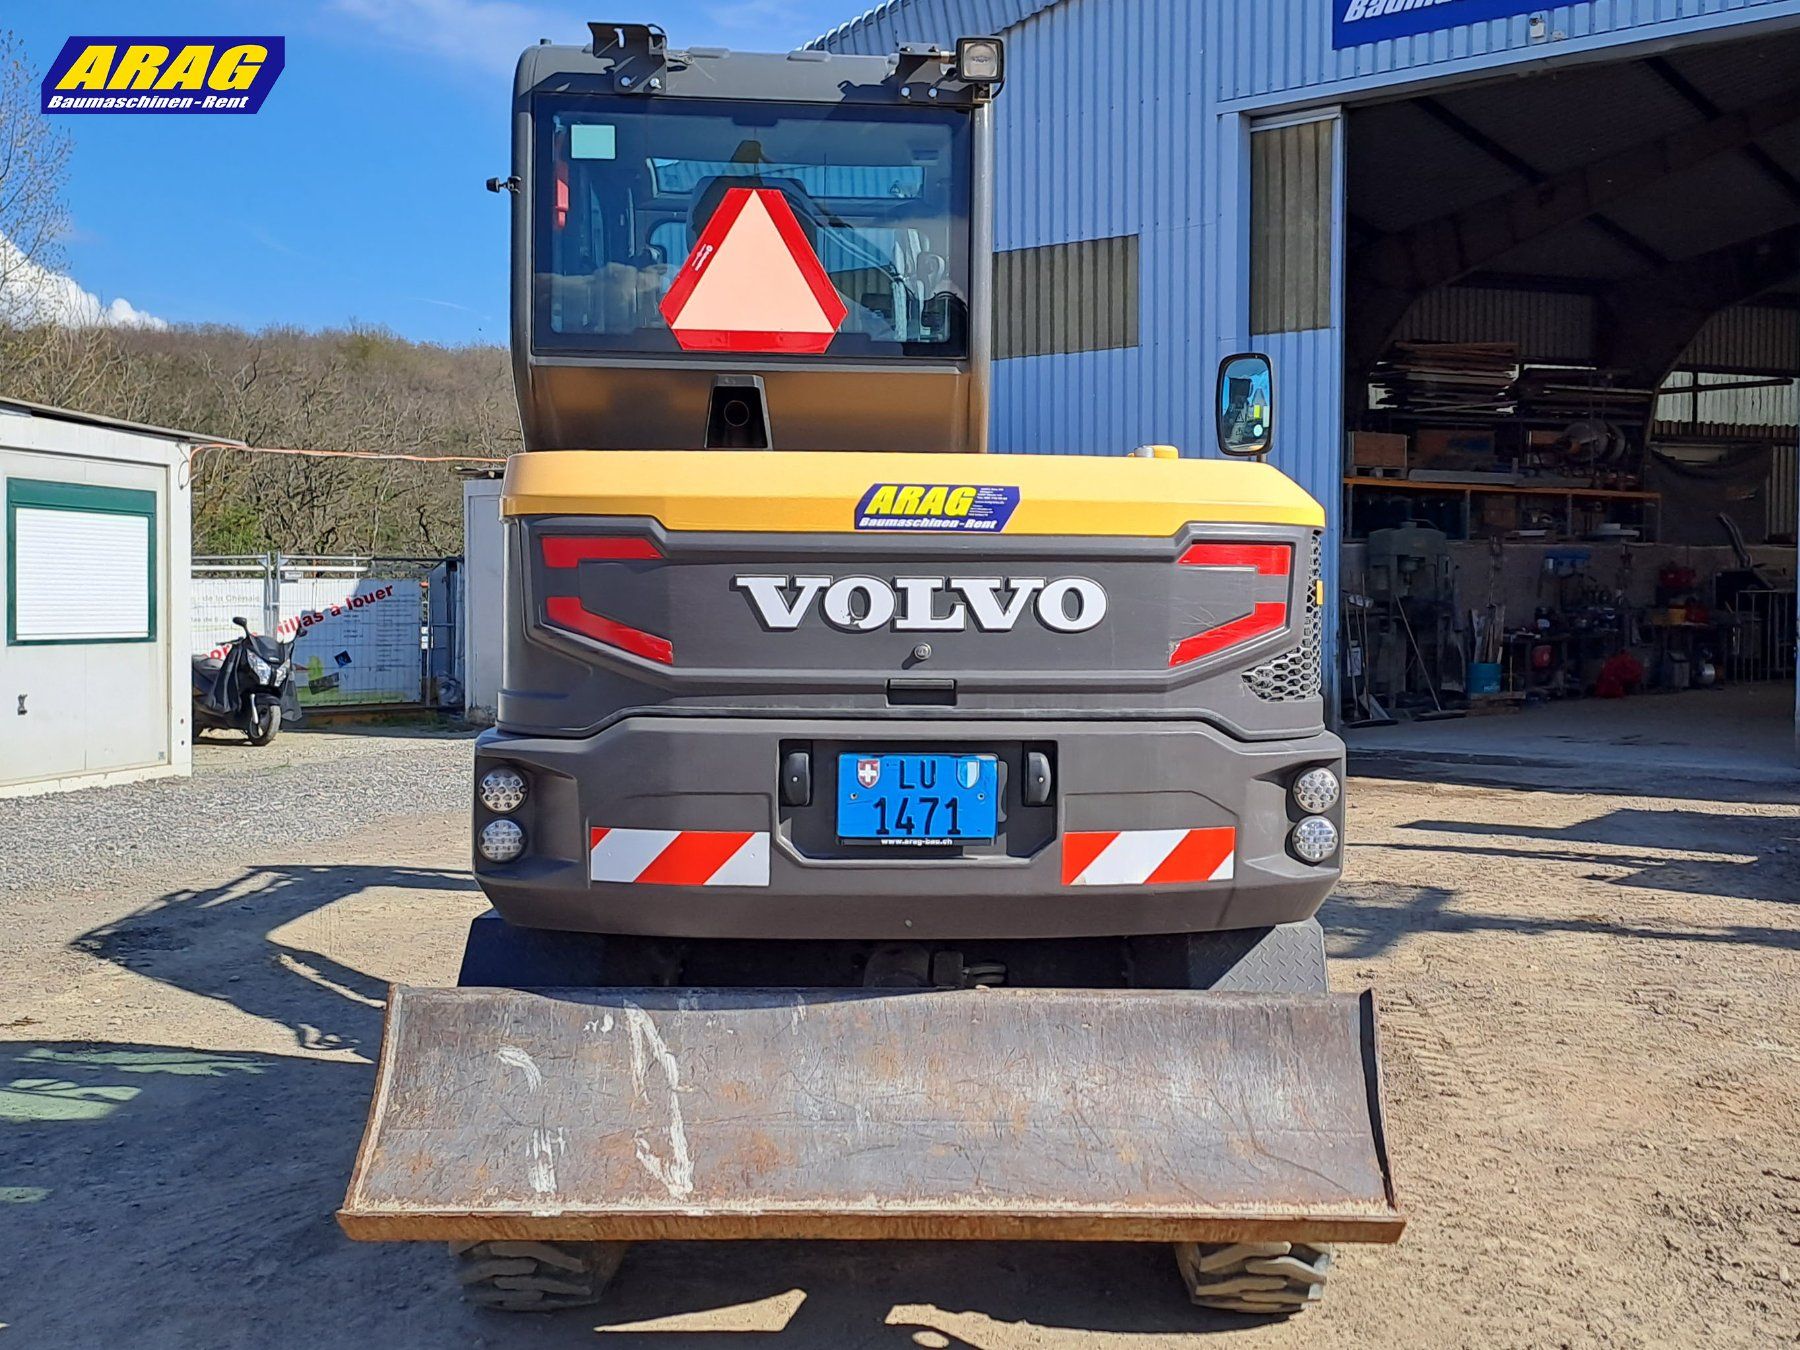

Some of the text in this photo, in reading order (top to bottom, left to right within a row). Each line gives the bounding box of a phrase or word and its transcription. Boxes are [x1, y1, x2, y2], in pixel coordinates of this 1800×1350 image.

[864, 485, 977, 517] ARAG
[859, 517, 997, 530] Baumaschinen-Rent
[329, 602, 341, 617] à
[345, 585, 393, 611] louer
[734, 576, 1108, 632] VOLVO
[899, 759, 937, 790] LU
[872, 796, 962, 836] 1471
